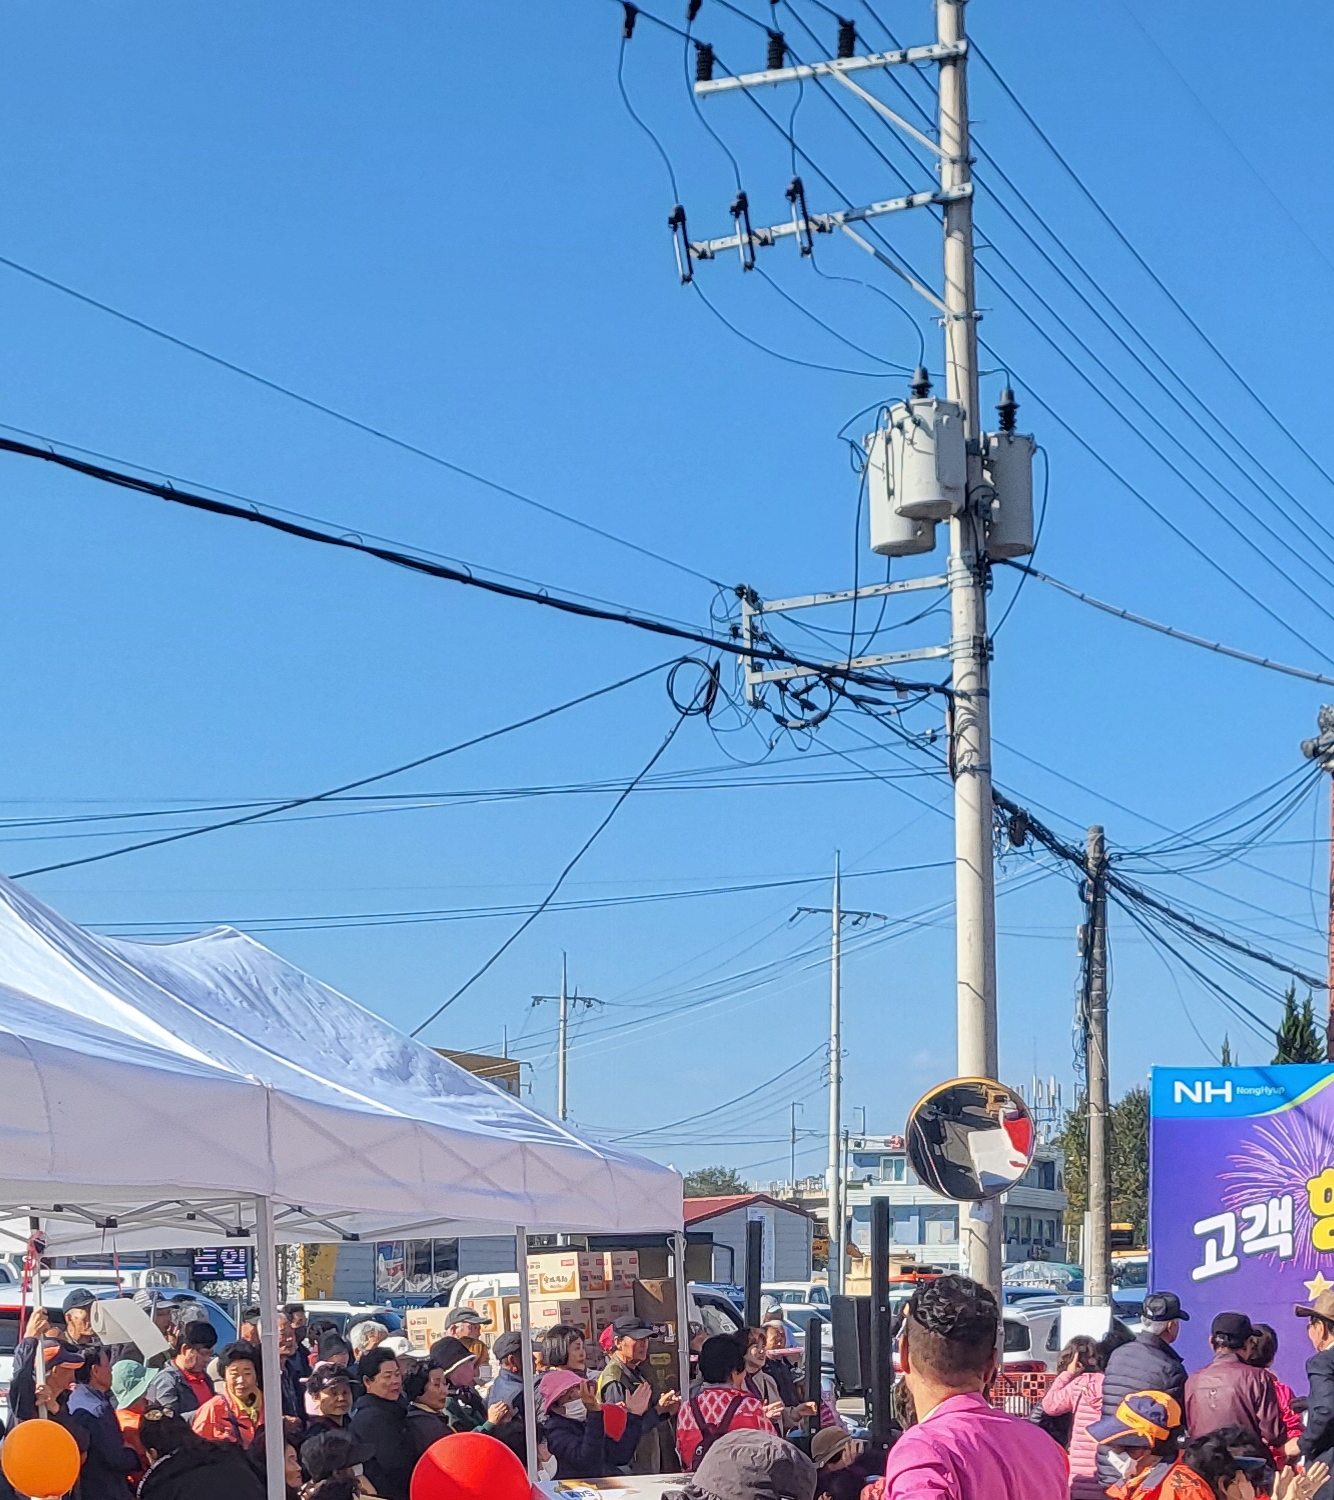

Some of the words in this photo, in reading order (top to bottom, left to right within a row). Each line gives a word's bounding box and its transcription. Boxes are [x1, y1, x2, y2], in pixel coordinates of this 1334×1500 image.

[1173, 1080, 1233, 1103] NH
[1236, 1085, 1285, 1097] NongHyup
[1192, 1194, 1294, 1281] 고객
